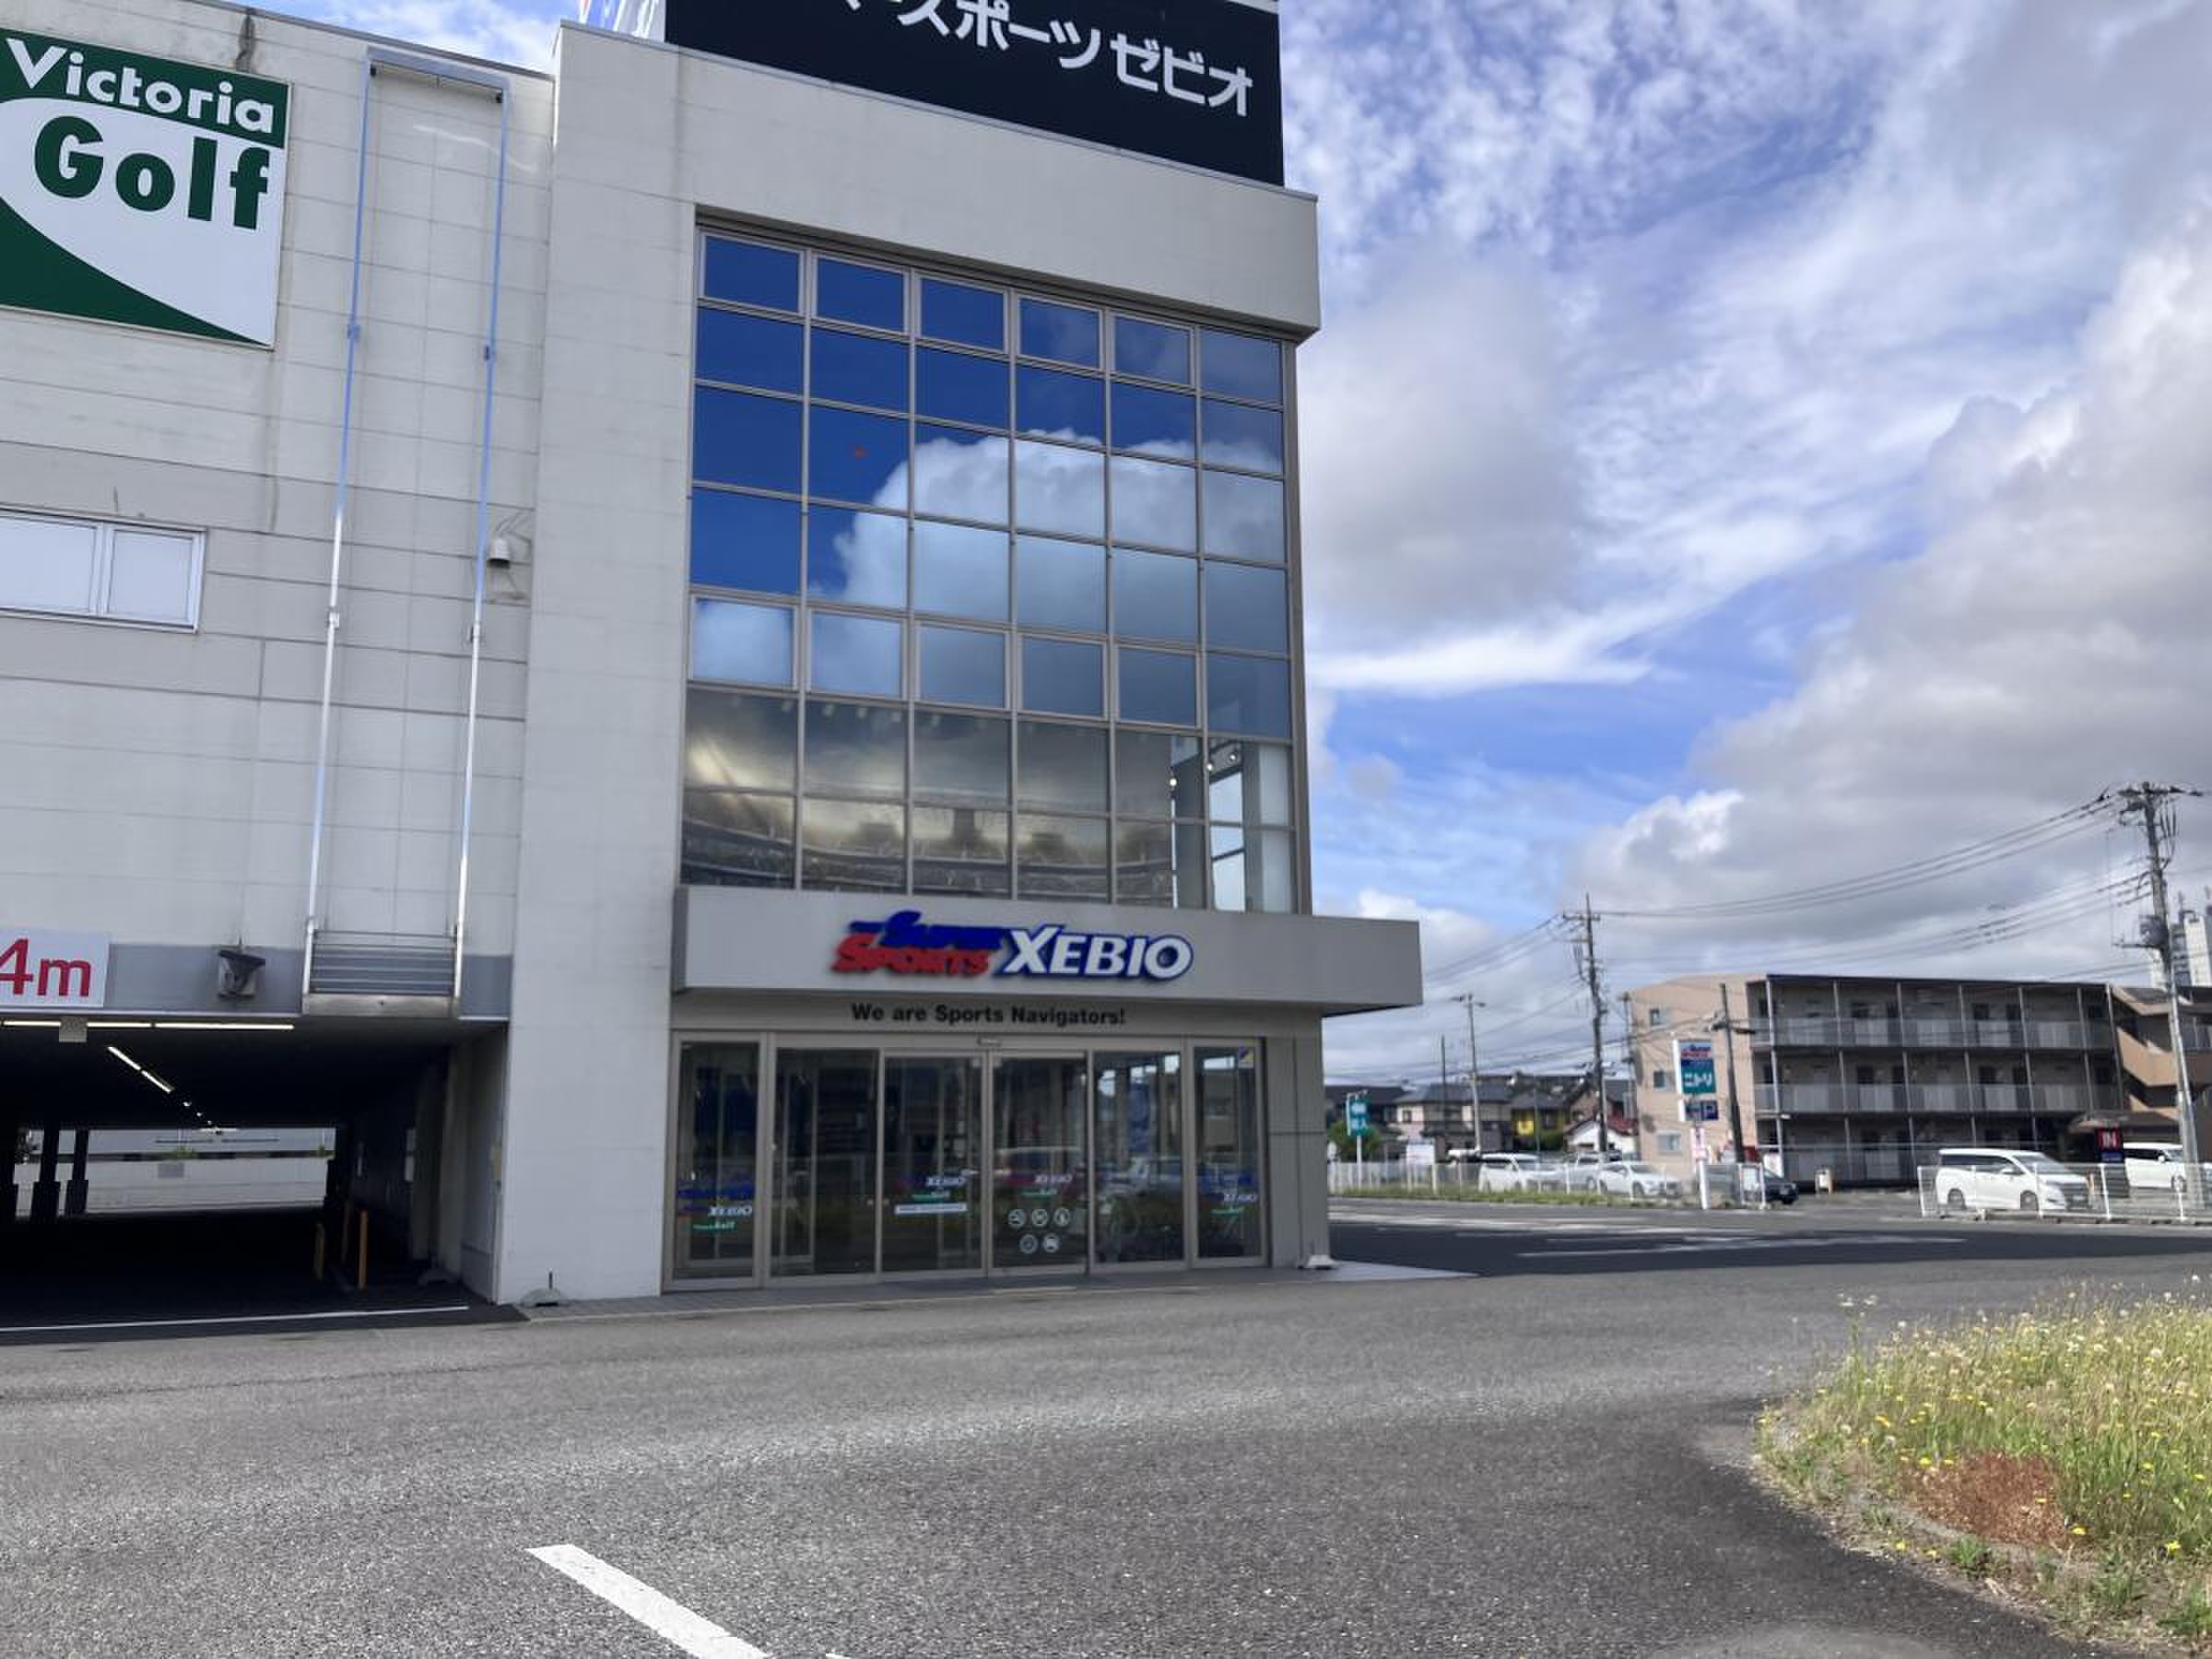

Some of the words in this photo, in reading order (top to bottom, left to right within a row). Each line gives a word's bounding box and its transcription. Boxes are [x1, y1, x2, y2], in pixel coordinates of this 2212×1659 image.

[6, 38, 275, 134] Victoria
[846, 0, 1253, 116] スポーツゼビオ
[34, 115, 270, 230] Golf
[1001, 924, 1194, 981] XEBIO
[851, 1003, 884, 1021] We
[891, 1006, 926, 1021] are
[935, 1004, 1004, 1026] Sports
[1011, 1006, 1126, 1027] Navigators!
